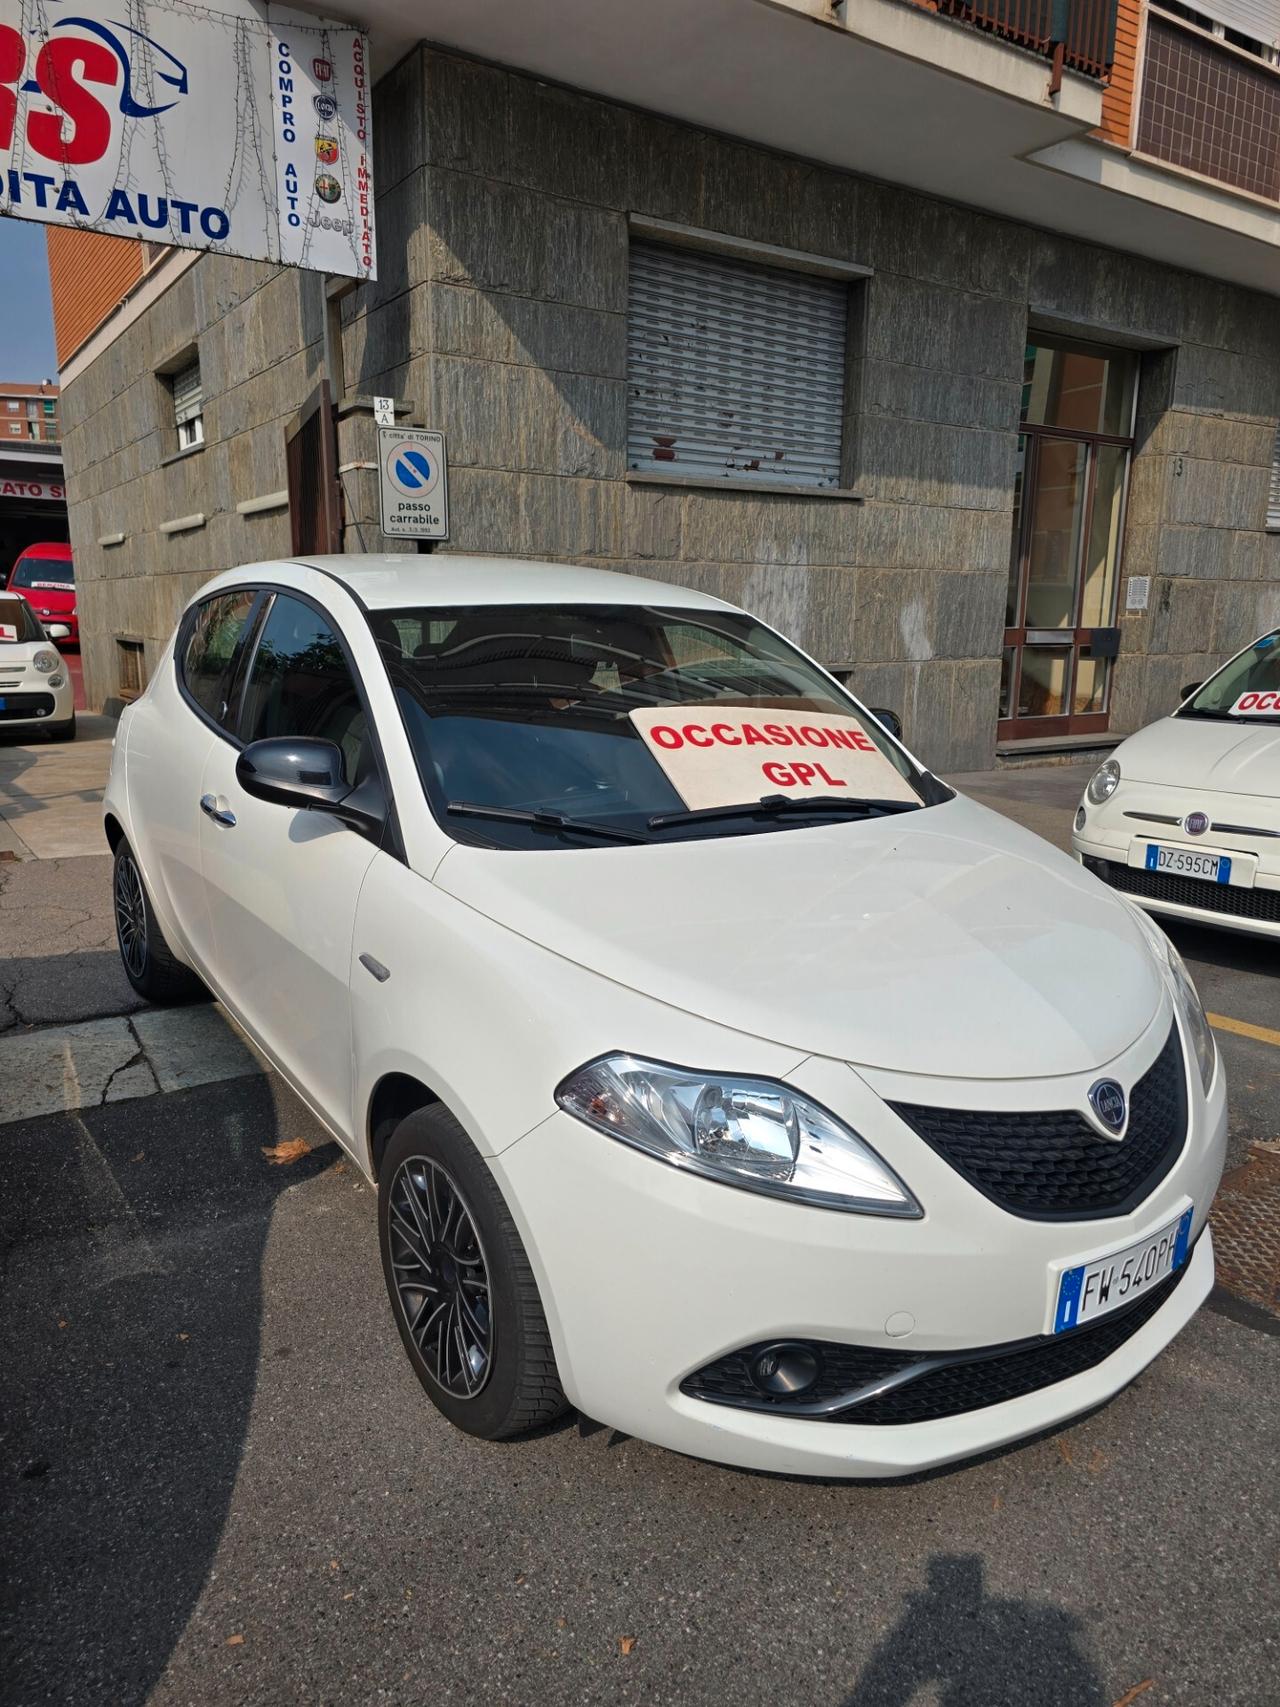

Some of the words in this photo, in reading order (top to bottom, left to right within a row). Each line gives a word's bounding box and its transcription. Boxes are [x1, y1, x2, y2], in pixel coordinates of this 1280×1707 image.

[278, 42, 297, 143] COMPRO
[352, 38, 366, 140] ACQUISTO
[0, 169, 90, 216] ITA
[105, 188, 230, 240] AUTO
[285, 163, 300, 227] AUTO
[308, 210, 354, 236] Jeep
[357, 155, 372, 266] IMMEDIATO
[379, 399, 389, 410] 13
[381, 413, 389, 424] A
[416, 434, 441, 442] TORINO
[389, 514, 440, 525] carrabile
[398, 502, 431, 512] passo
[650, 723, 877, 752] OCCASIONE
[761, 762, 848, 787] GPL
